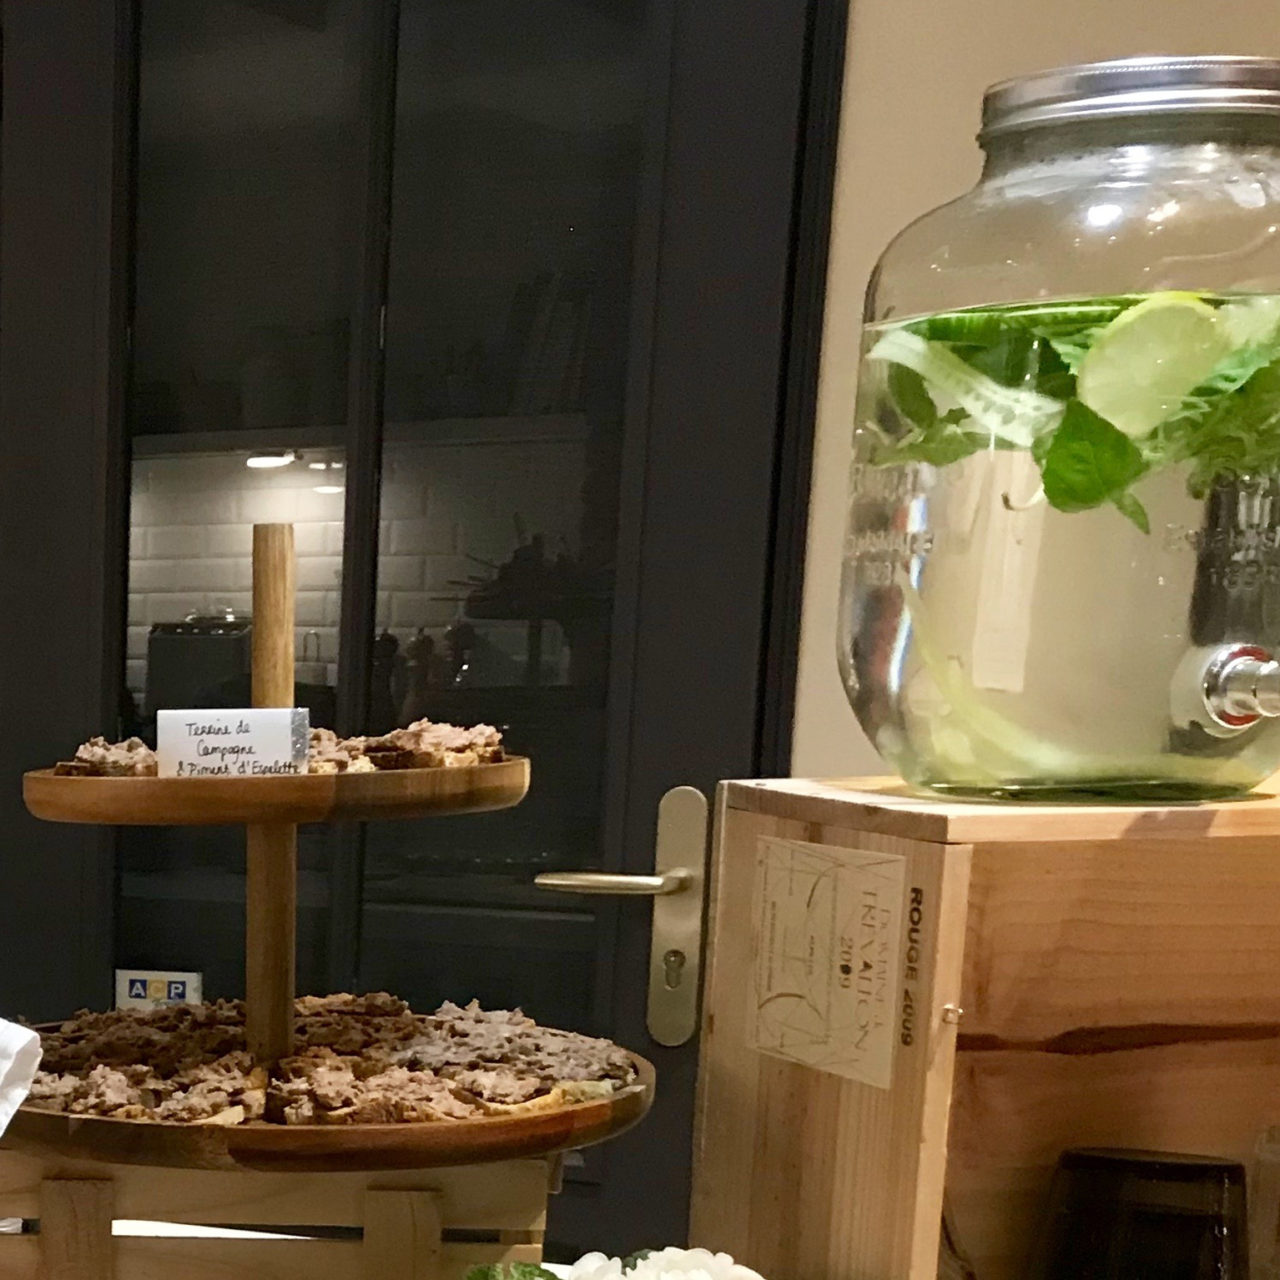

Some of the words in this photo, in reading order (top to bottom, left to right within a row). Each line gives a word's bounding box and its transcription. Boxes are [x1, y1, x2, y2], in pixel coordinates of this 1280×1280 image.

[185, 722, 231, 737] Terrine
[236, 719, 251, 734] de
[197, 739, 257, 764] Campagne
[187, 762, 231, 776] Piment
[904, 887, 924, 981] ROUGE
[900, 988, 916, 1047] 2009
